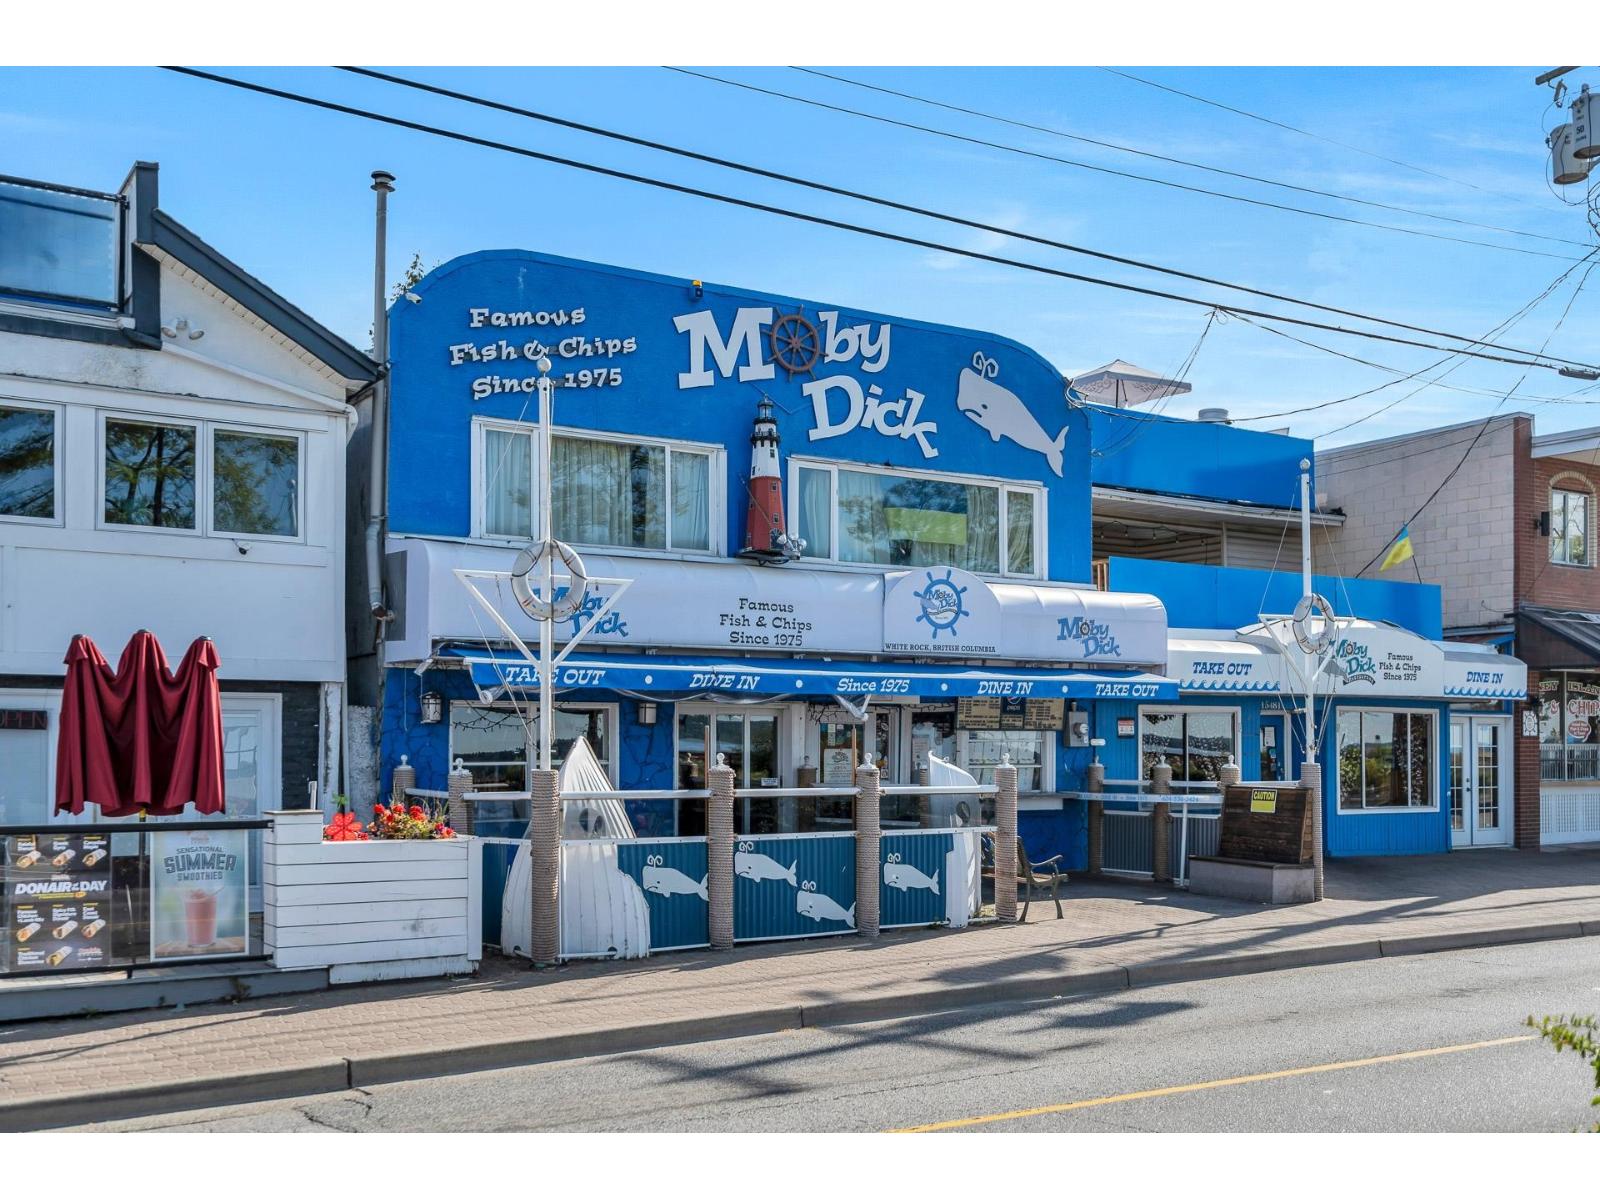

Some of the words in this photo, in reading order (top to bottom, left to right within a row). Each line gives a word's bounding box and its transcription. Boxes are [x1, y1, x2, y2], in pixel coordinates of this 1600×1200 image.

[469, 307, 586, 328] Famous
[450, 340, 518, 365] Fish
[523, 340, 549, 361] &
[558, 336, 637, 358] Chips
[672, 307, 891, 389] Moby
[564, 368, 622, 388] 1975
[802, 374, 939, 459] Dick
[739, 598, 794, 613] Famous
[719, 614, 751, 627] Fish
[755, 616, 767, 628] &
[772, 617, 812, 633] Chips
[1056, 616, 1110, 641] Moby
[729, 631, 769, 645] Since
[774, 634, 803, 646] 1975
[932, 644, 960, 652] BRITISH
[960, 645, 996, 653] COLUMBIA
[1081, 636, 1121, 658] Dick
[1387, 652, 1413, 661] Famous
[1192, 661, 1225, 675] TAKE
[1227, 662, 1252, 676] OUT
[1346, 656, 1376, 676] Dick
[1379, 662, 1393, 671] Fish
[1395, 663, 1401, 671] &
[1402, 663, 1421, 673] Chips
[563, 669, 606, 685] OUT
[689, 673, 736, 689] DINE
[737, 675, 760, 690] IN
[1383, 672, 1402, 681] Since
[1465, 671, 1491, 684] DINE
[1492, 672, 1504, 684] IN
[837, 678, 877, 692] Since
[880, 679, 910, 693] 1975
[977, 681, 1013, 695] DINE
[1014, 682, 1033, 696] IN
[1095, 683, 1130, 697] TAKE
[1132, 684, 1159, 697] OUT
[1253, 791, 1275, 800] CAUTION
[176, 846, 224, 854] SENSATIONAL
[164, 853, 237, 874] SUMMER
[177, 871, 223, 881] SMOOTHIES
[15, 881, 72, 894] DONAIR
[80, 880, 107, 892] DAY
